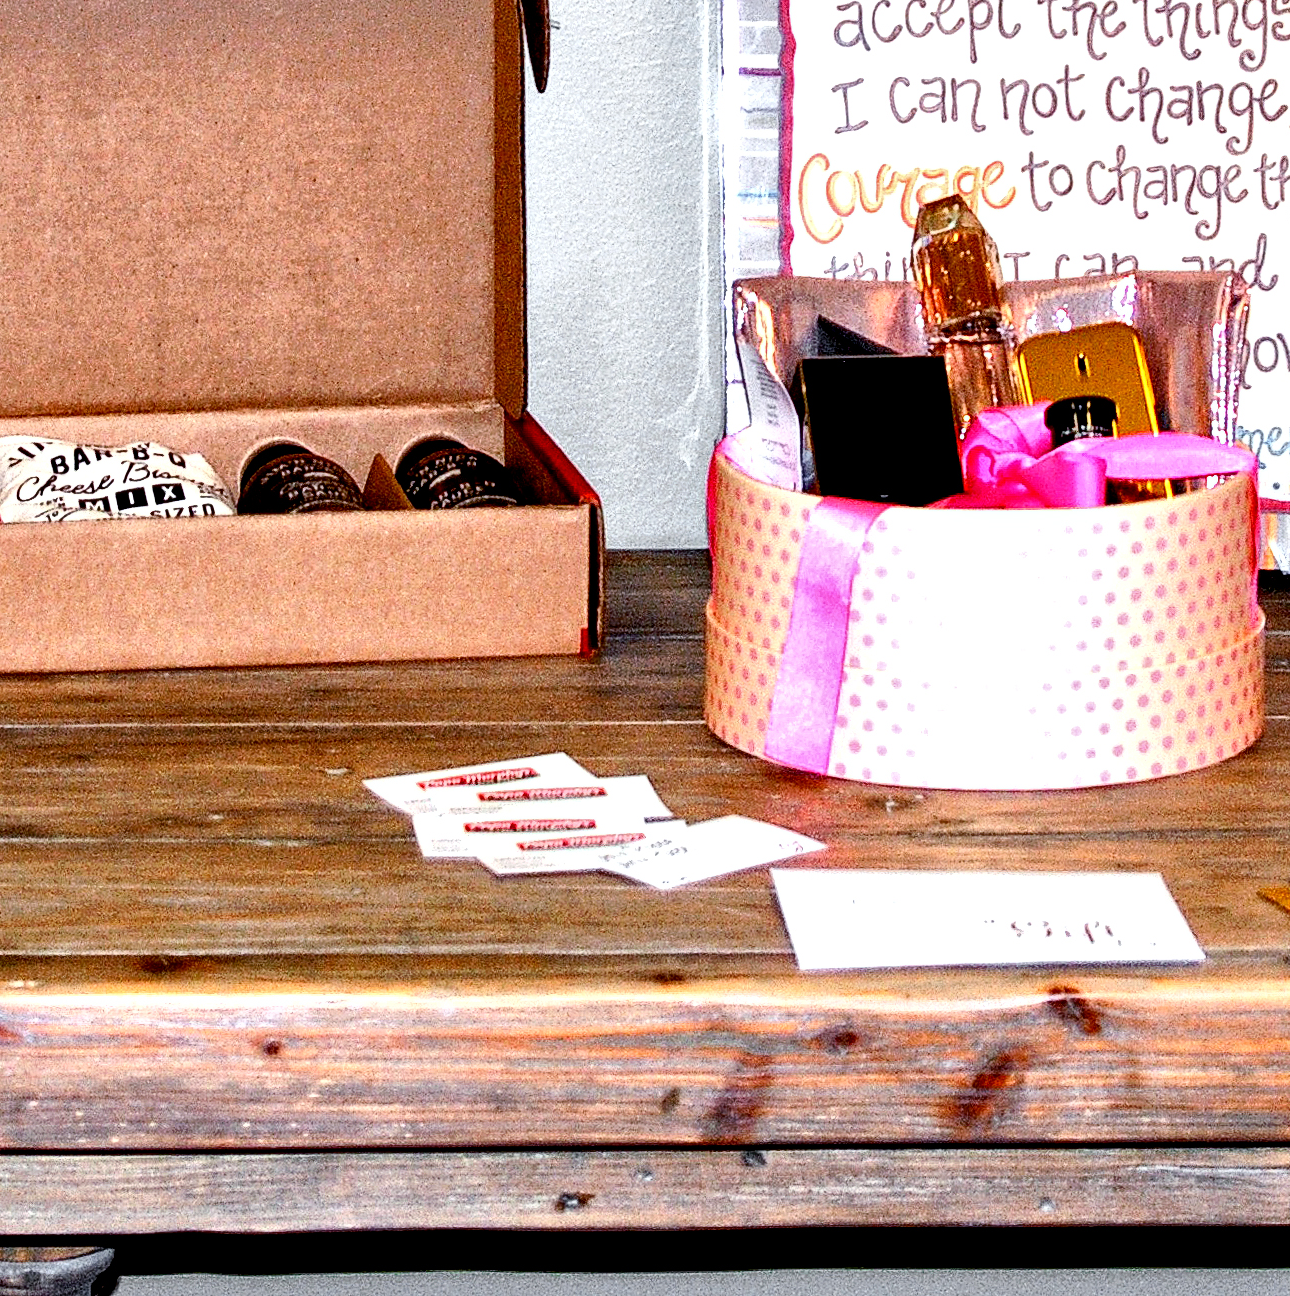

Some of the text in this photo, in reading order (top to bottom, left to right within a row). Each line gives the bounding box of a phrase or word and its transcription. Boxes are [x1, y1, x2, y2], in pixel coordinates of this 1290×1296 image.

[832, 77, 870, 134] I
[889, 72, 984, 132] can
[1001, 65, 1088, 134] not
[1020, 151, 1073, 213] to
[1084, 147, 1247, 241] change
[16, 474, 115, 502] Cheese
